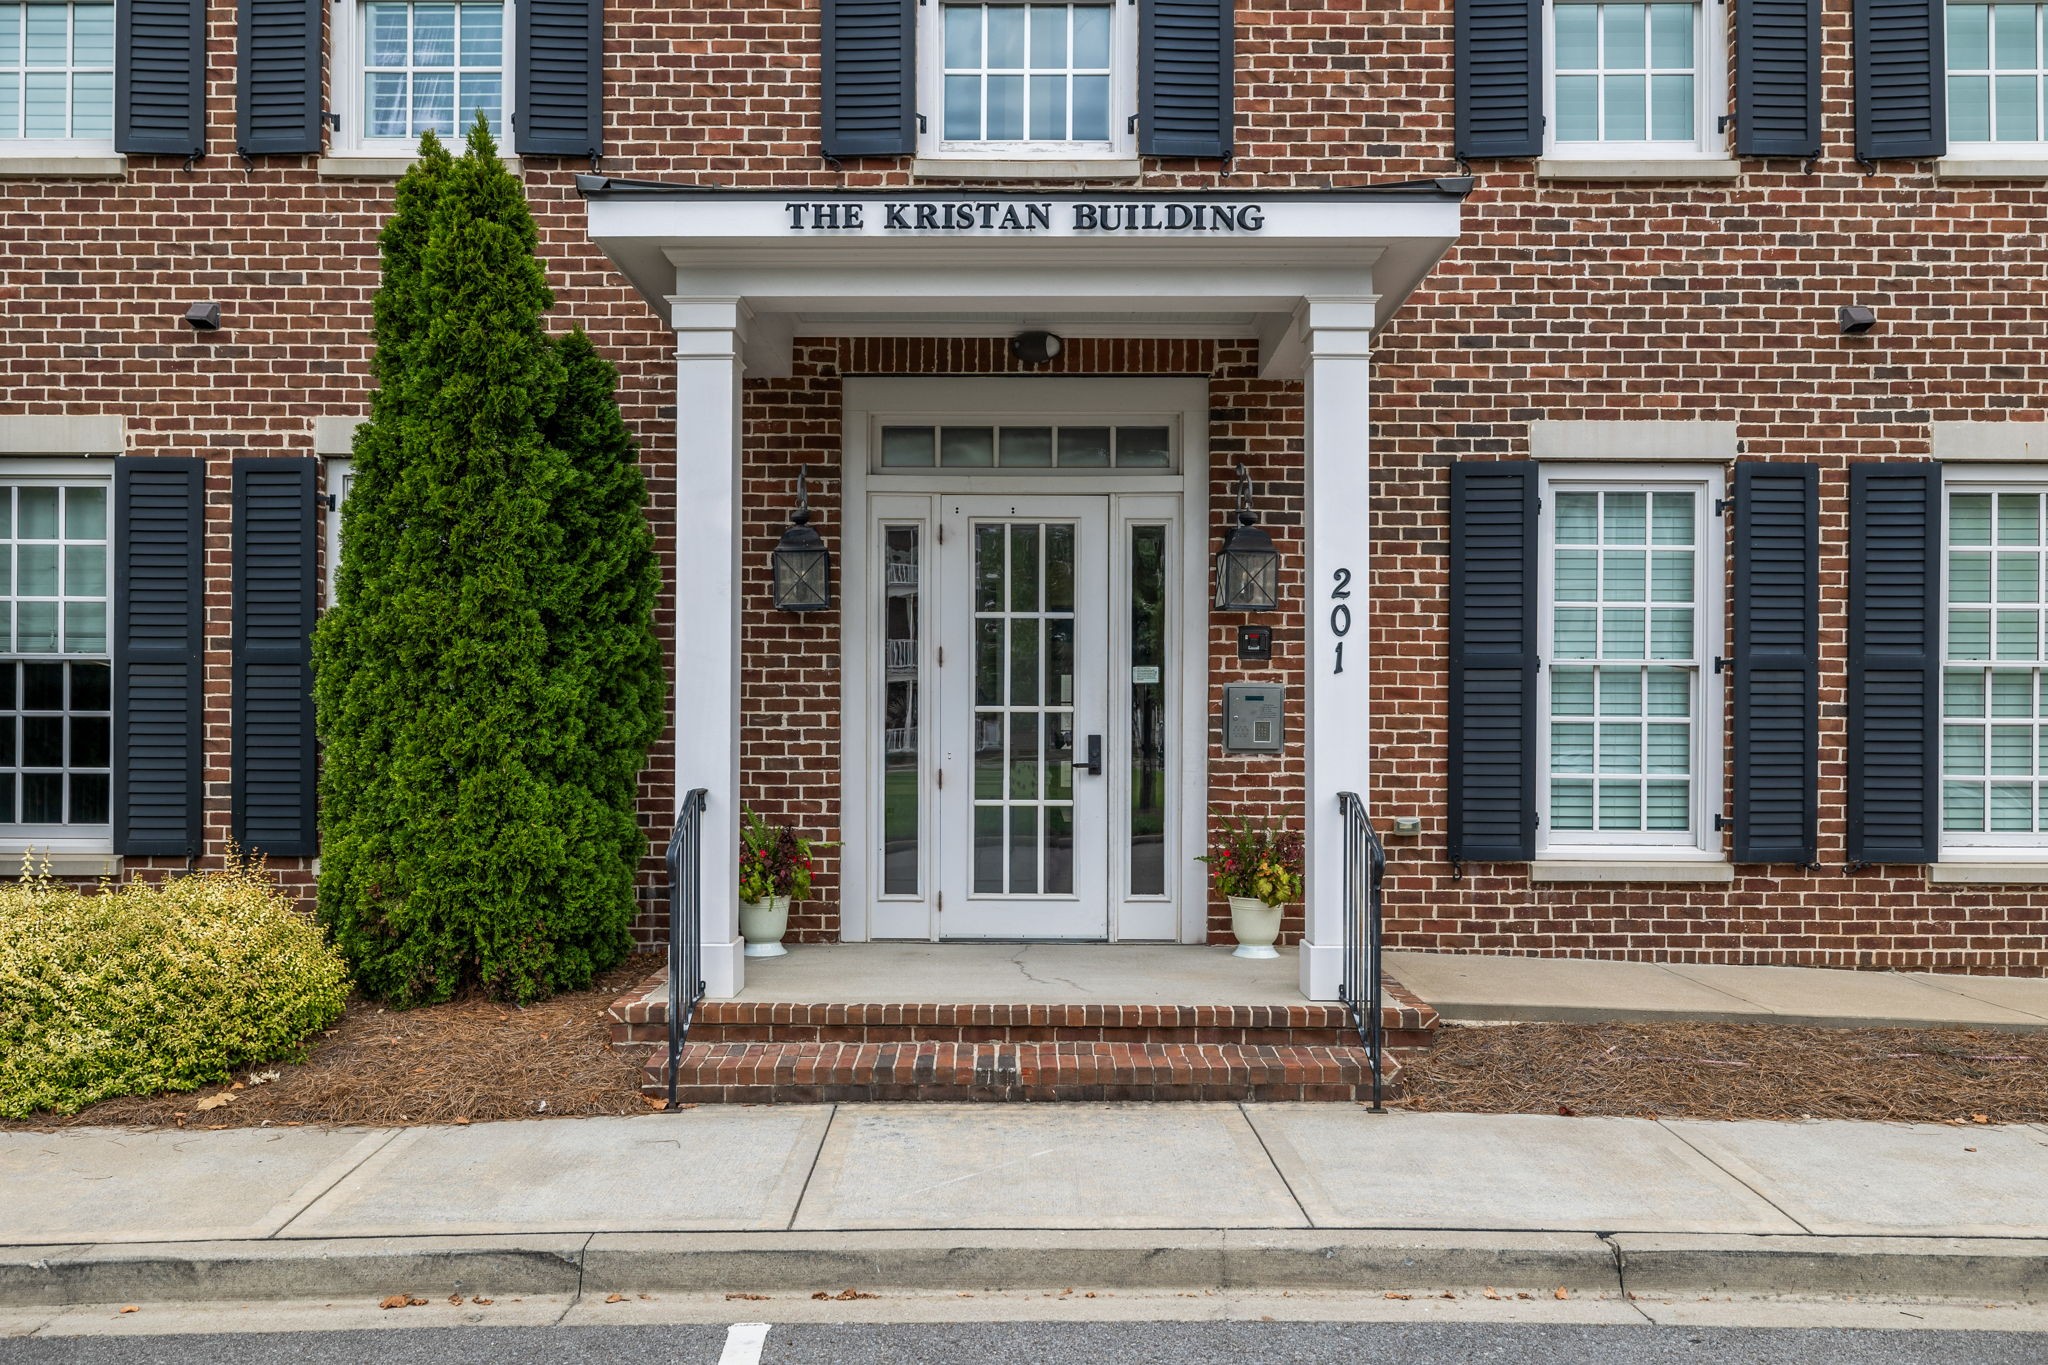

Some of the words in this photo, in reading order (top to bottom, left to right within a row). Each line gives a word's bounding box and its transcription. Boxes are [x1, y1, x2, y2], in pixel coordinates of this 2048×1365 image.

[785, 203, 864, 229] THE
[884, 202, 1052, 230] KRISTAN
[1072, 203, 1265, 231] BUILDING
[1330, 567, 1351, 675] 201
